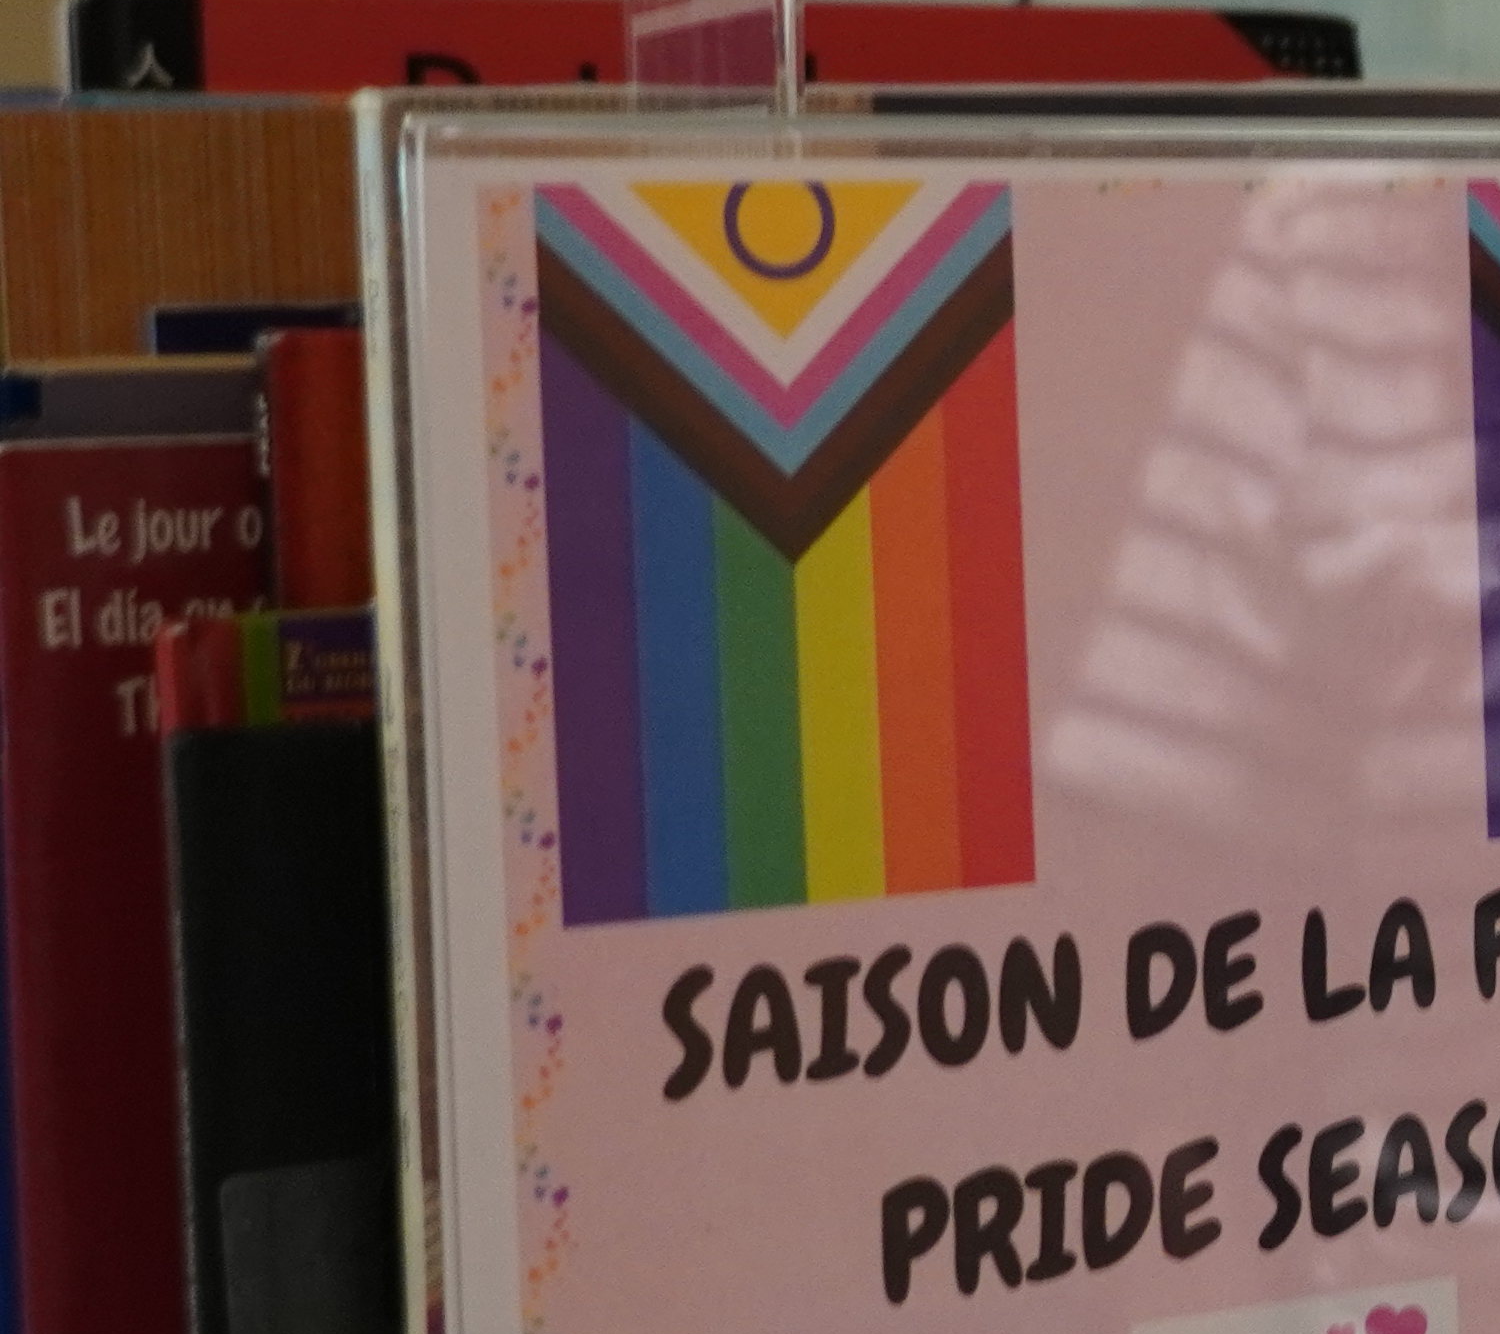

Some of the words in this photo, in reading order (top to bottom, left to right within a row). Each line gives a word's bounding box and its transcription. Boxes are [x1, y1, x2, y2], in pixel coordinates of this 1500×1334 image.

[66, 495, 122, 557] Le
[131, 497, 223, 564] jour
[38, 587, 83, 649] El
[661, 931, 1082, 1102] SAISON
[1124, 910, 1265, 1041] DE
[1301, 896, 1437, 1024] LA
[880, 1136, 1222, 1306] PRIDE
